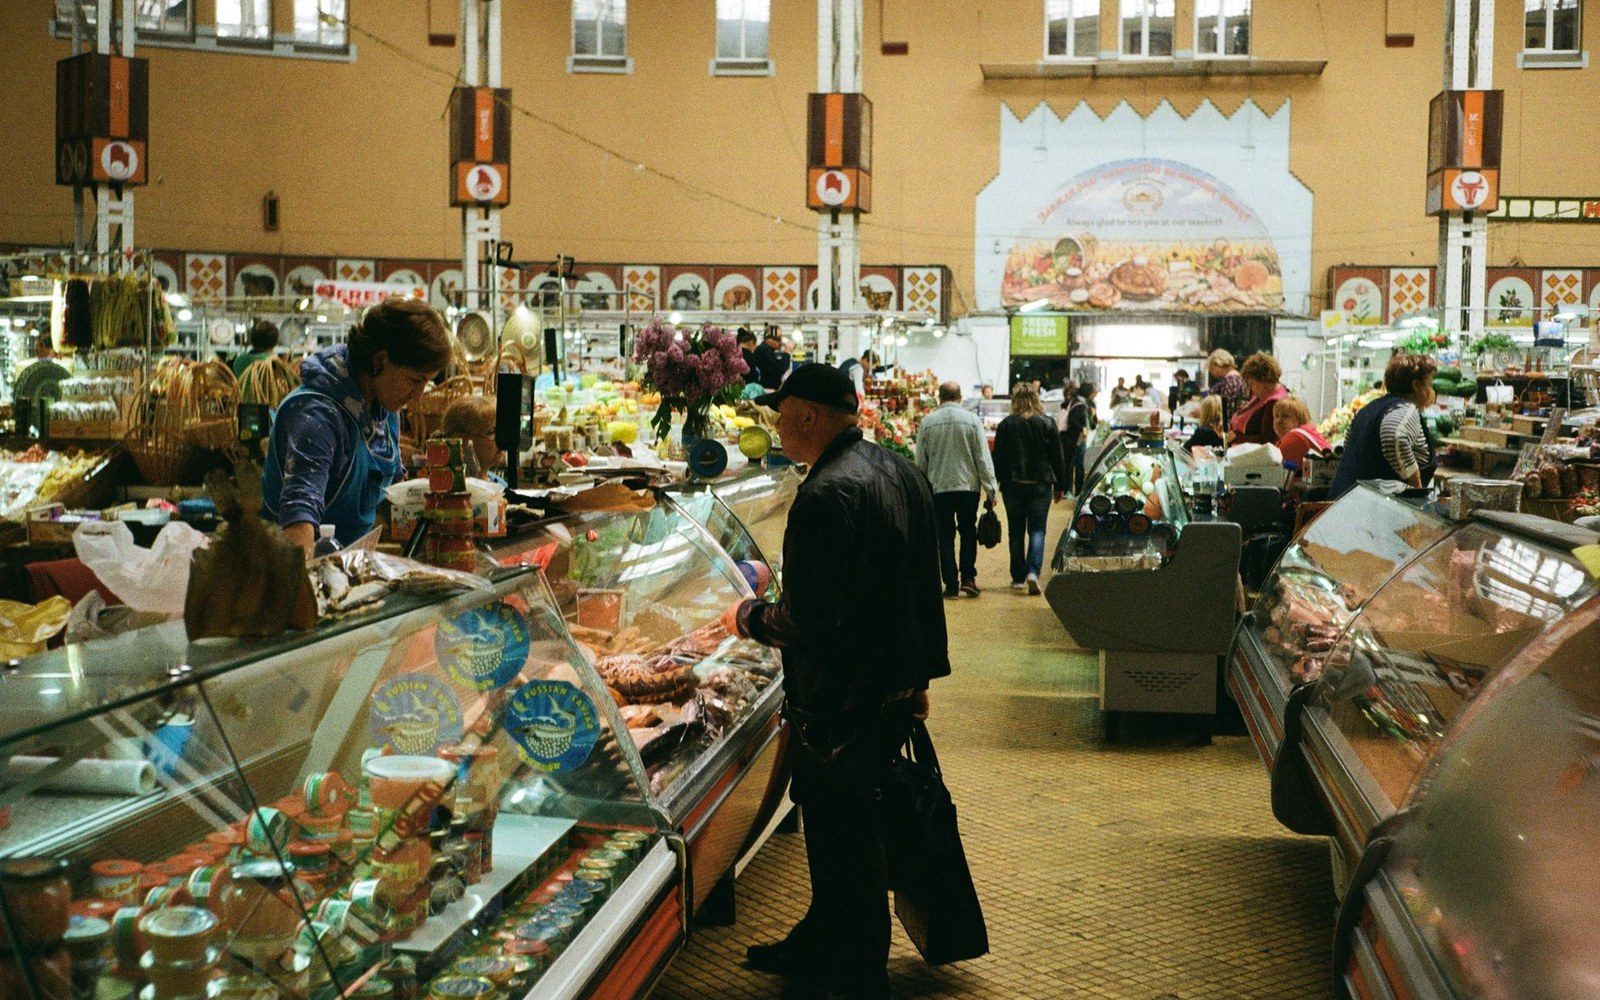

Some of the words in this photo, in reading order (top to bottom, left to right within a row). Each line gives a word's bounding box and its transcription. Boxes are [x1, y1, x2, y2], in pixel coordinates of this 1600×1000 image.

[1021, 327, 1056, 338] FRESH
[385, 681, 429, 699] RUSSIAN
[523, 684, 568, 700] RUSSIAN
[571, 695, 595, 730] CAVIAR
